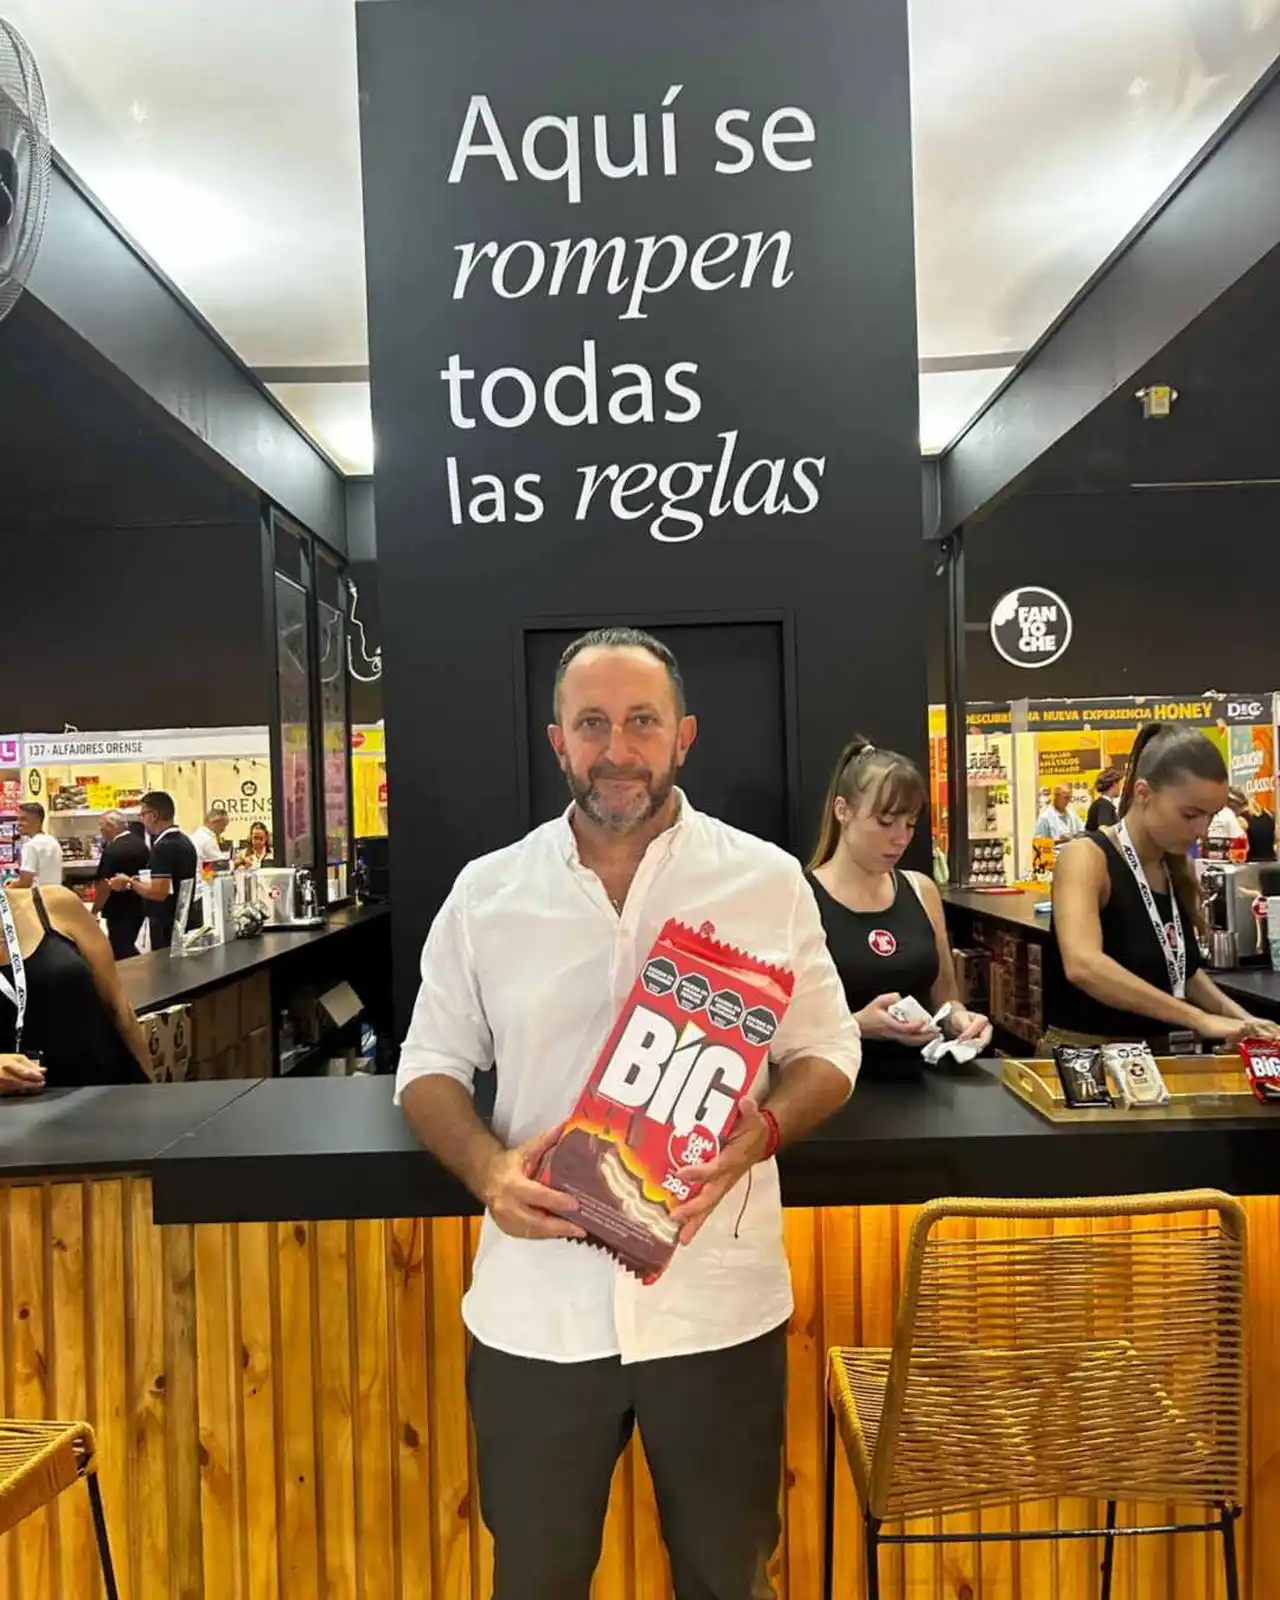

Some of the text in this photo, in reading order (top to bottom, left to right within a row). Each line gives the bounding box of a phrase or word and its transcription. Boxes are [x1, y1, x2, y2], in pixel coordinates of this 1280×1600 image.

[448, 85, 816, 204] Aquí se
[453, 230, 794, 320] rompen
[441, 340, 702, 429] todas
[447, 430, 826, 542] las reglas
[1018, 606, 1057, 622] FAN
[1020, 621, 1047, 637] TO
[1018, 635, 1057, 652] CHE
[1154, 702, 1212, 719] HONEY
[28, 744, 45, 757] 137
[52, 743, 105, 756] ALFAJORES
[106, 742, 143, 755] ORENSE
[211, 798, 272, 813] ORENS
